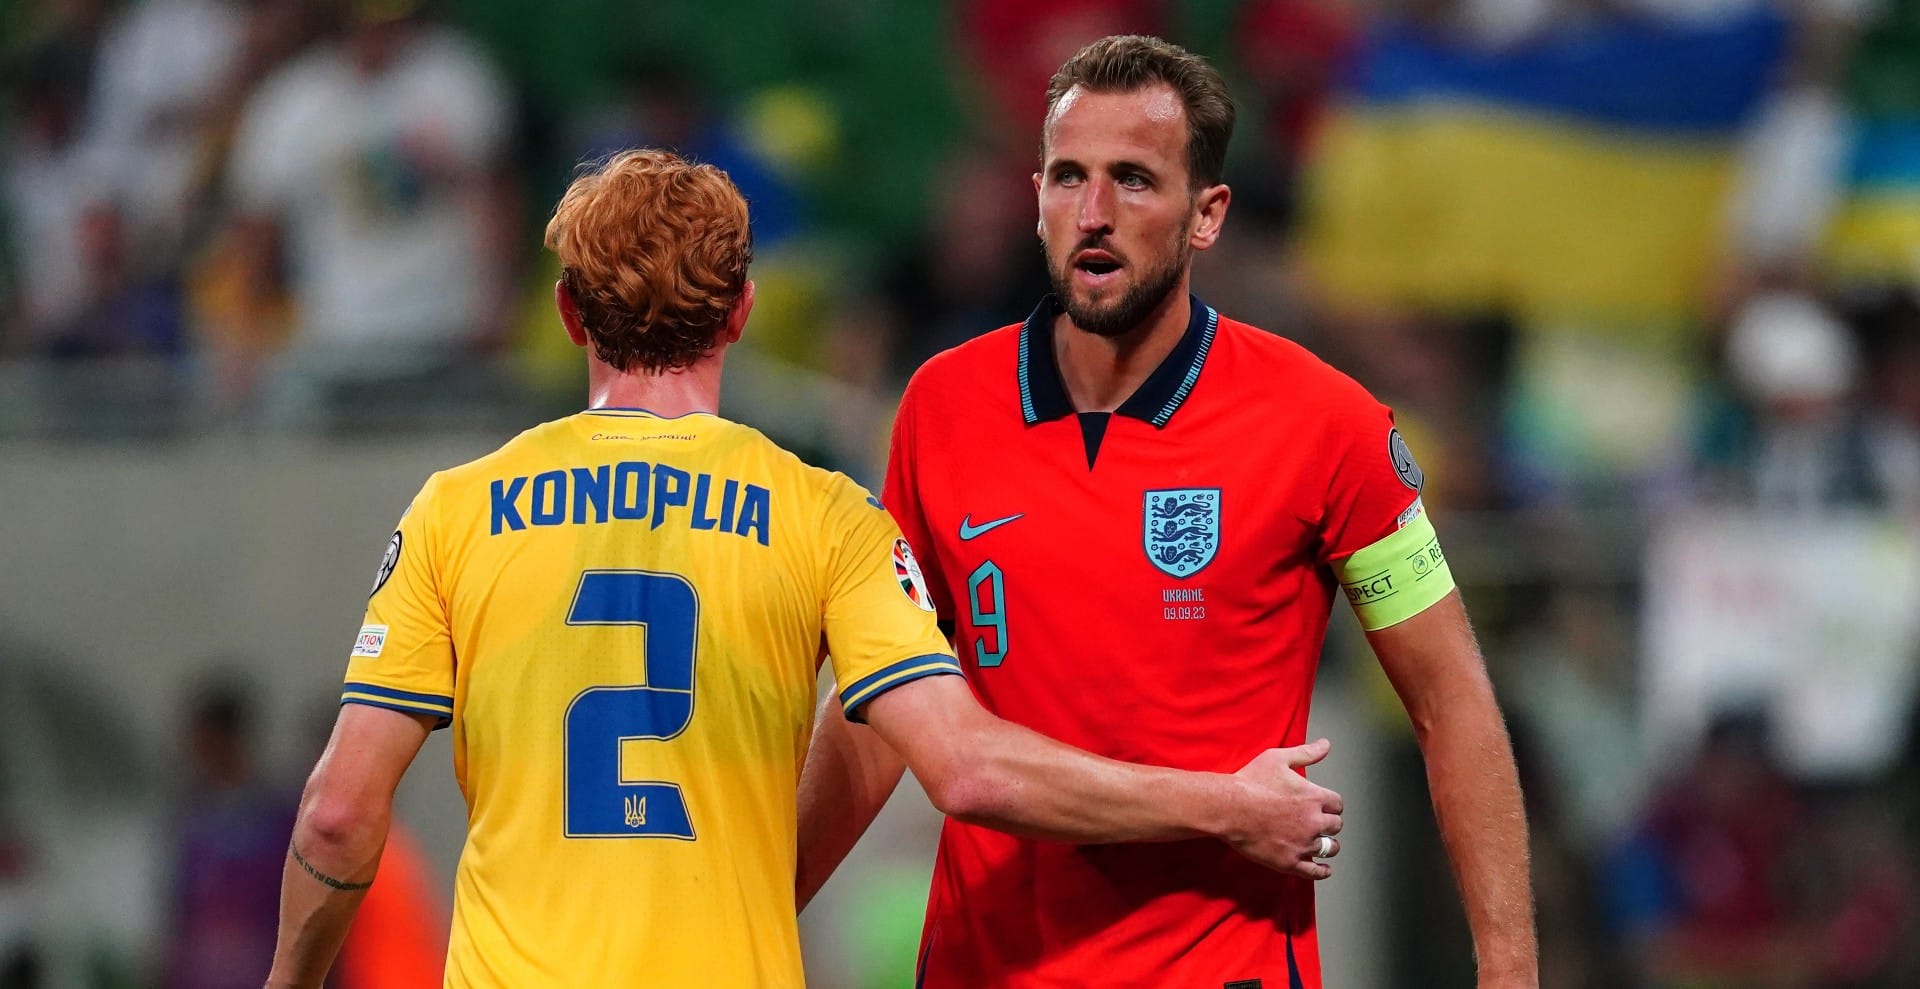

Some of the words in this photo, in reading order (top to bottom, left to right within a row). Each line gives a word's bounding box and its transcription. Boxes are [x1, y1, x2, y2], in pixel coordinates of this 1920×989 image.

[490, 461, 770, 547] KONOPLIA
[967, 558, 1009, 668] 9
[1162, 588, 1205, 602] UKRAINE
[1163, 606, 1206, 620] 09.09.23
[563, 568, 700, 842] 2
